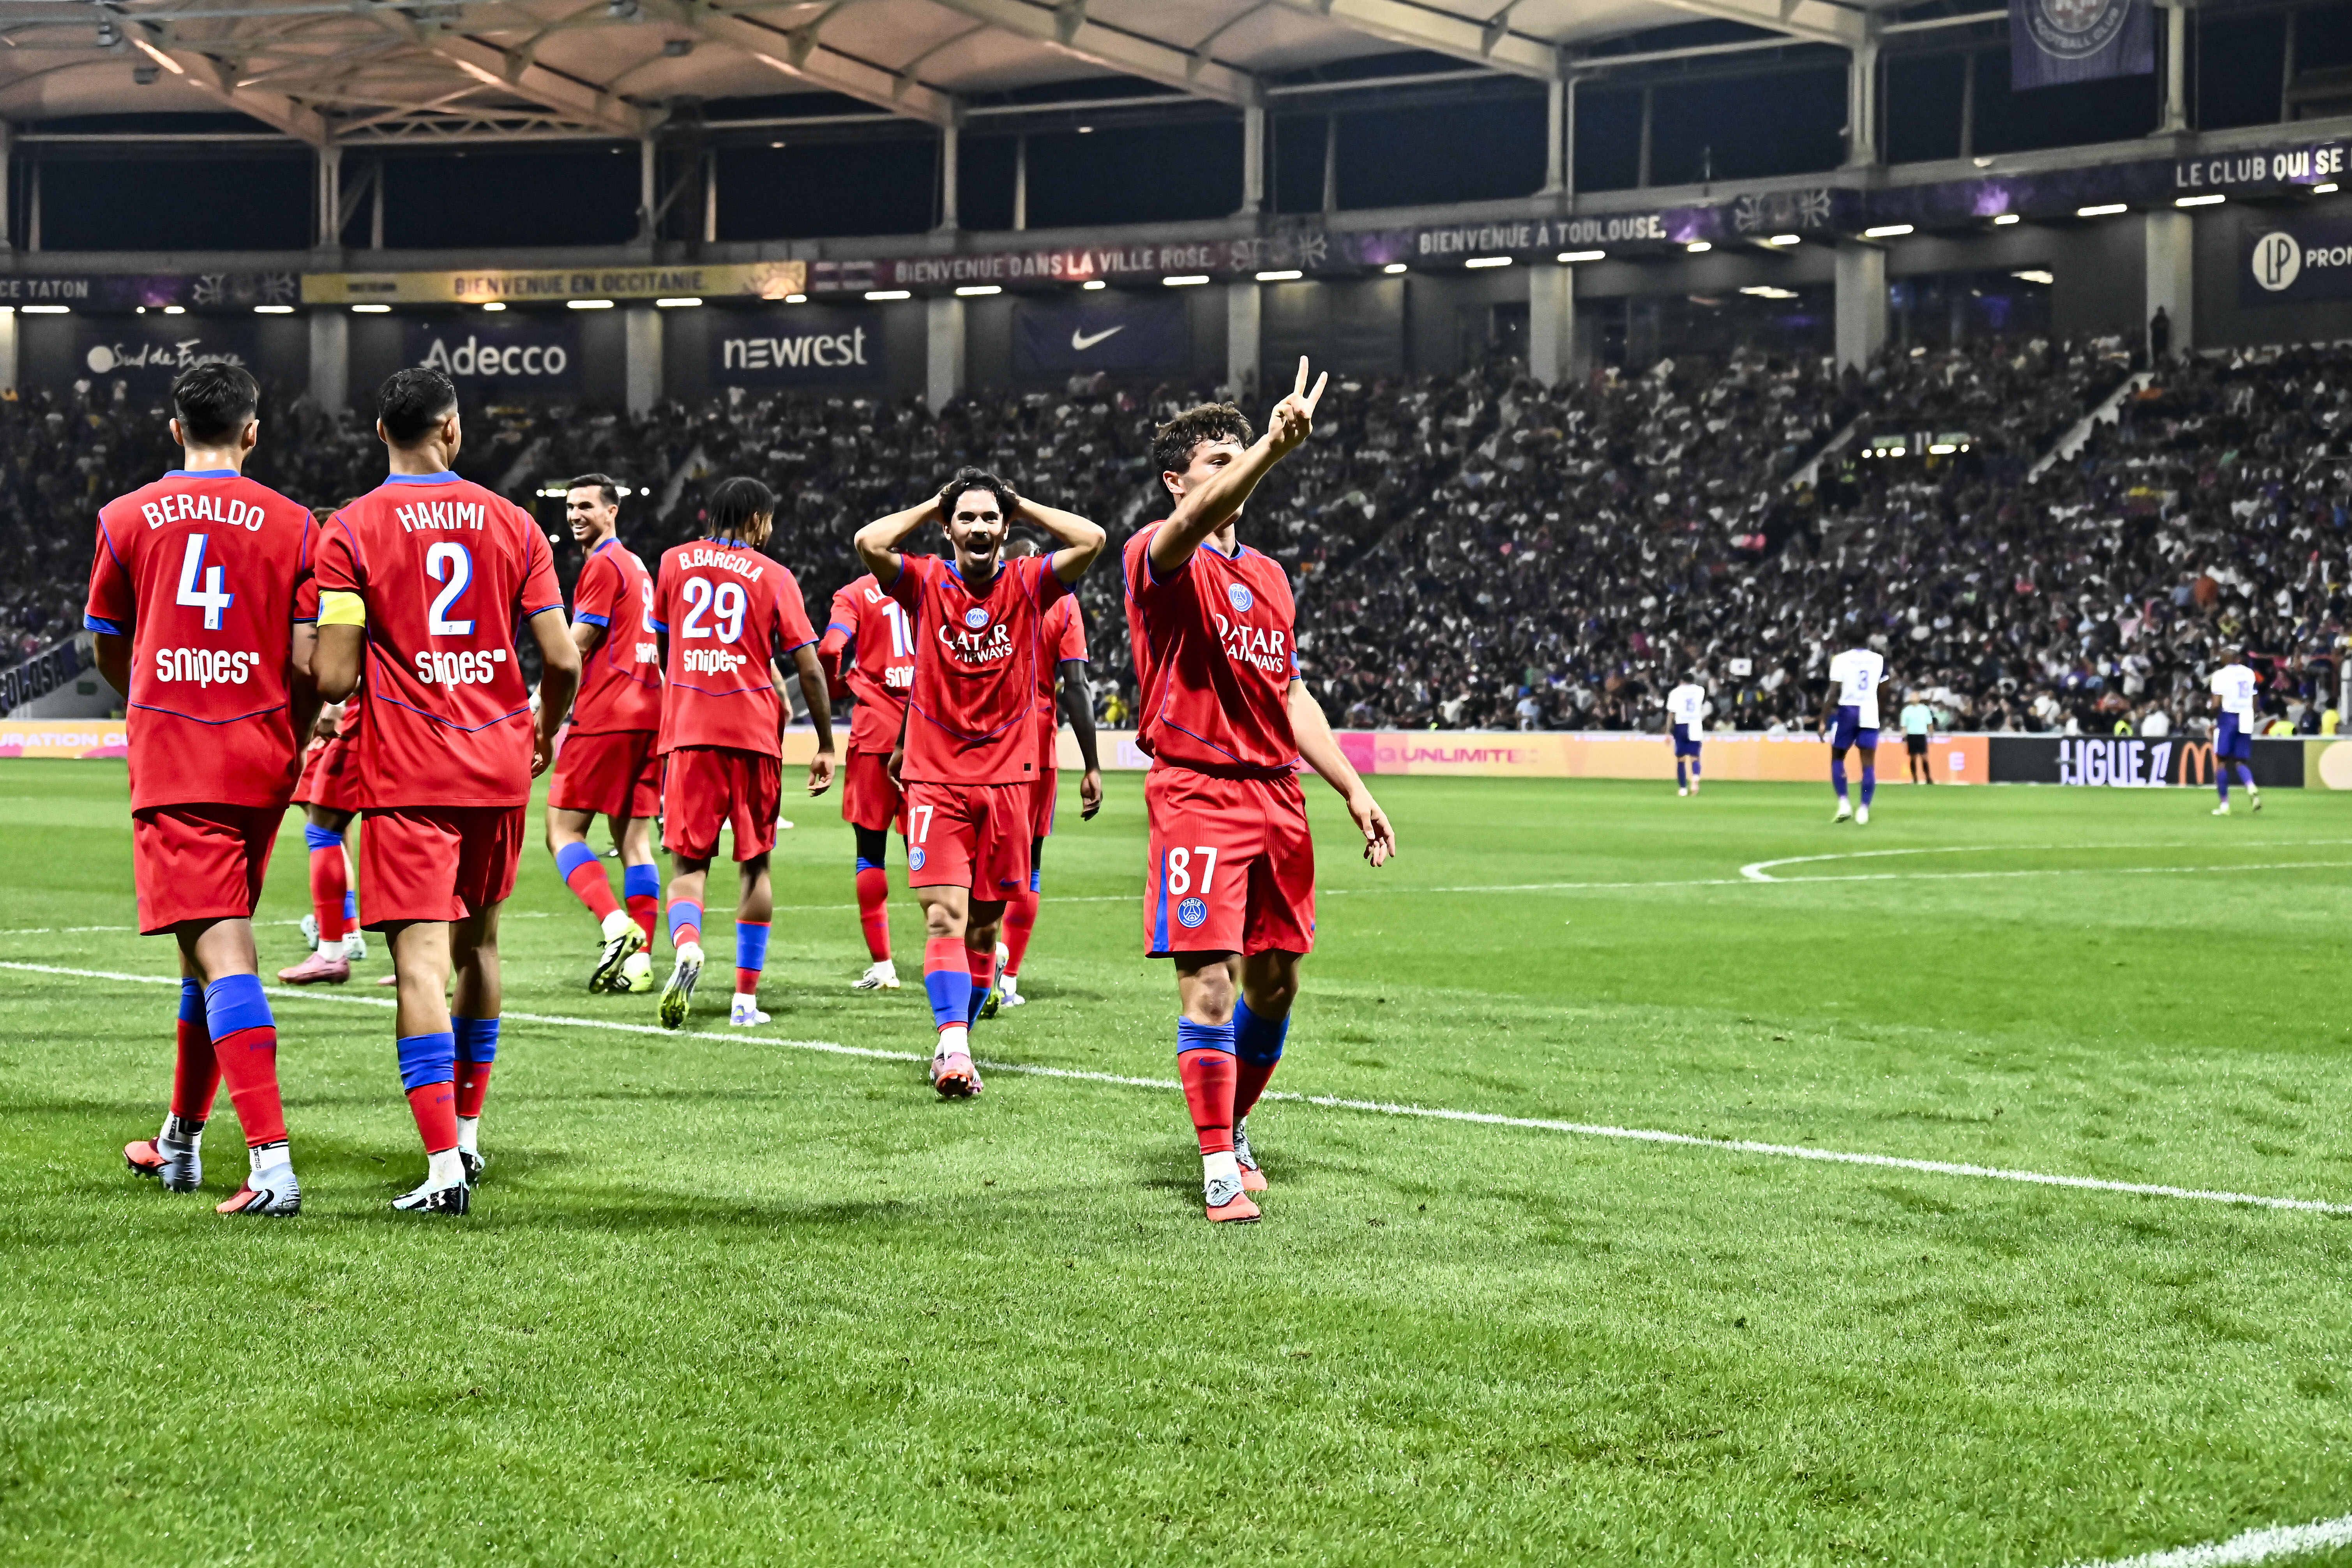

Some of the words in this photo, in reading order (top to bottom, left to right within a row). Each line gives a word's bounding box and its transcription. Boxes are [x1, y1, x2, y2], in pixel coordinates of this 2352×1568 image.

[2177, 162, 2203, 187] LE
[2209, 157, 2266, 184] CLUB
[2273, 151, 2310, 181] QUI
[2315, 148, 2343, 175] SE
[1420, 224, 1530, 254] BIENVENUE
[454, 275, 565, 296] BIENVENUE
[571, 274, 595, 294] EN
[896, 256, 1004, 283] BIENVENUE
[1011, 253, 1062, 275] DANS
[1066, 252, 1093, 274] LA
[1100, 249, 1154, 272] VILLE
[27, 280, 88, 298] TATON
[112, 343, 149, 368] Sud
[149, 348, 176, 366] de
[419, 335, 567, 376] Adecco
[141, 494, 265, 531] BERALDO
[396, 501, 485, 533] HAKIMI
[176, 533, 234, 630] 4
[678, 548, 764, 583] B.BARCOLA
[426, 542, 476, 636] 2
[682, 576, 747, 645] 29
[0, 650, 66, 709] OLOSA
[156, 648, 250, 689] snipes
[1858, 669, 1869, 690] 3
[1403, 748, 1538, 764] UNLIMITE
[2060, 738, 2146, 787] LIGUE
[909, 805, 934, 844] 17
[1168, 846, 1218, 895] 87
